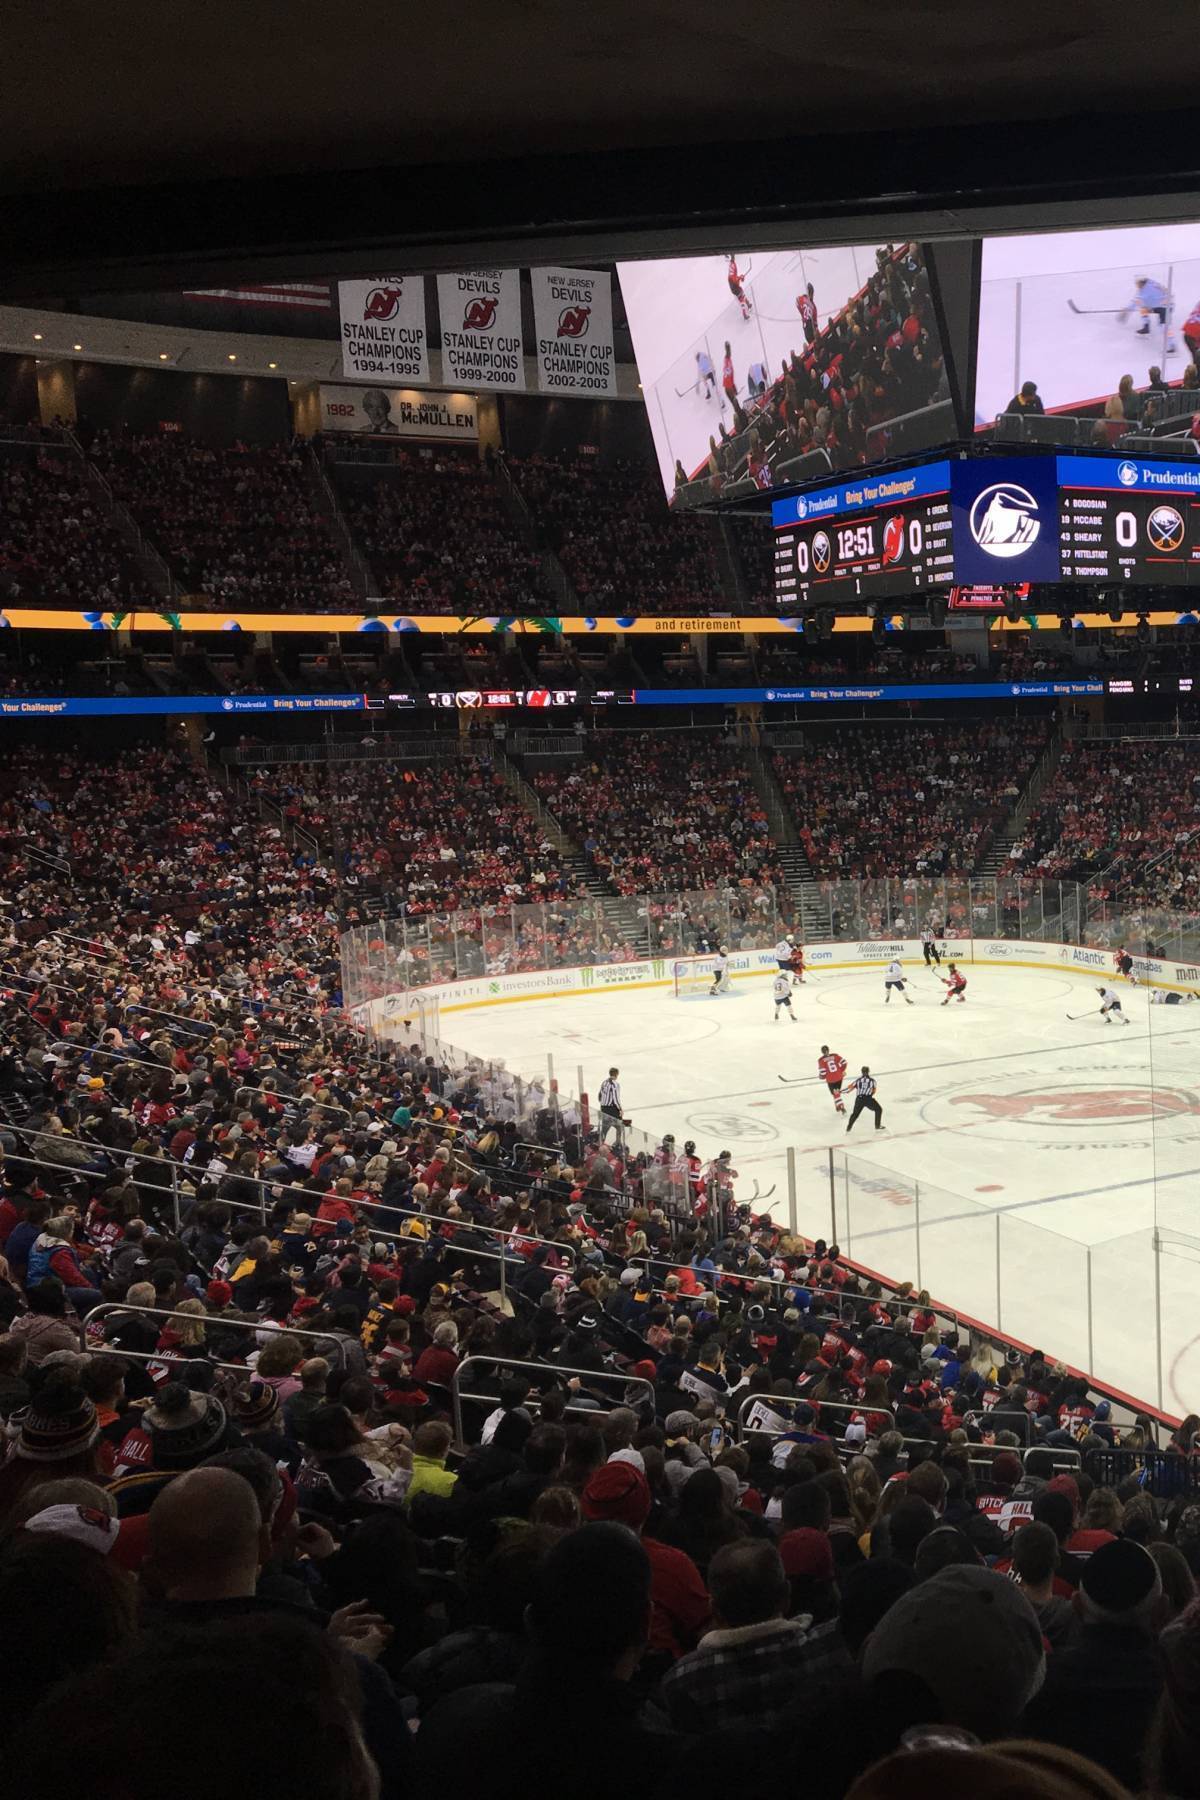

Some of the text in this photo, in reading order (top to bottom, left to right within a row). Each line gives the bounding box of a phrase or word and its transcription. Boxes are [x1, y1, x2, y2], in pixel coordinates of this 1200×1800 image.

[458, 279, 500, 294] DEVILS
[547, 276, 595, 289] NEW JERSEY
[551, 287, 592, 303] DEVILS
[343, 323, 424, 344] STANLEY CUP
[443, 332, 521, 353] STANLEY CUP
[348, 341, 422, 361] CHAMPIONS
[539, 340, 613, 361] STANLEY CUP
[352, 359, 421, 376] 1994-1995
[448, 350, 519, 370] CHAMPIONS
[543, 358, 610, 377] CHAMPIONS
[452, 367, 517, 383] 1999-2000
[547, 374, 609, 390] 2002-2003
[325, 403, 356, 417] 1982
[416, 402, 439, 413] JOHN
[401, 410, 474, 428] McMULLEN
[808, 495, 838, 513] Prudential
[846, 491, 863, 505] Bring
[863, 488, 878, 500] Your
[1064, 499, 1070, 507] 4
[1061, 515, 1103, 525] 19 MCCABE
[1115, 511, 1137, 547] 0
[837, 526, 874, 560] 12:51
[909, 519, 923, 555] 0
[1060, 533, 1102, 542] 43 SHEARY
[797, 541, 809, 574] 0
[1061, 550, 1071, 559] 37
[1062, 567, 1109, 576] 72 THOMPSON
[1124, 568, 1131, 578] 5
[855, 579, 861, 594] 1
[655, 619, 741, 631] and retirement
[777, 690, 845, 699] Prudential Bring Your
[1053, 685, 1070, 693] Bring
[273, 699, 294, 710] Bring
[294, 699, 312, 708] Your
[441, 694, 451, 706] 0
[487, 694, 510, 704] 12:51
[556, 692, 564, 704] 0
[2, 703, 20, 713] Your
[1073, 949, 1106, 965] Atlantic
[828, 1060, 838, 1073] 6
[121, 1439, 150, 1462] HALL
